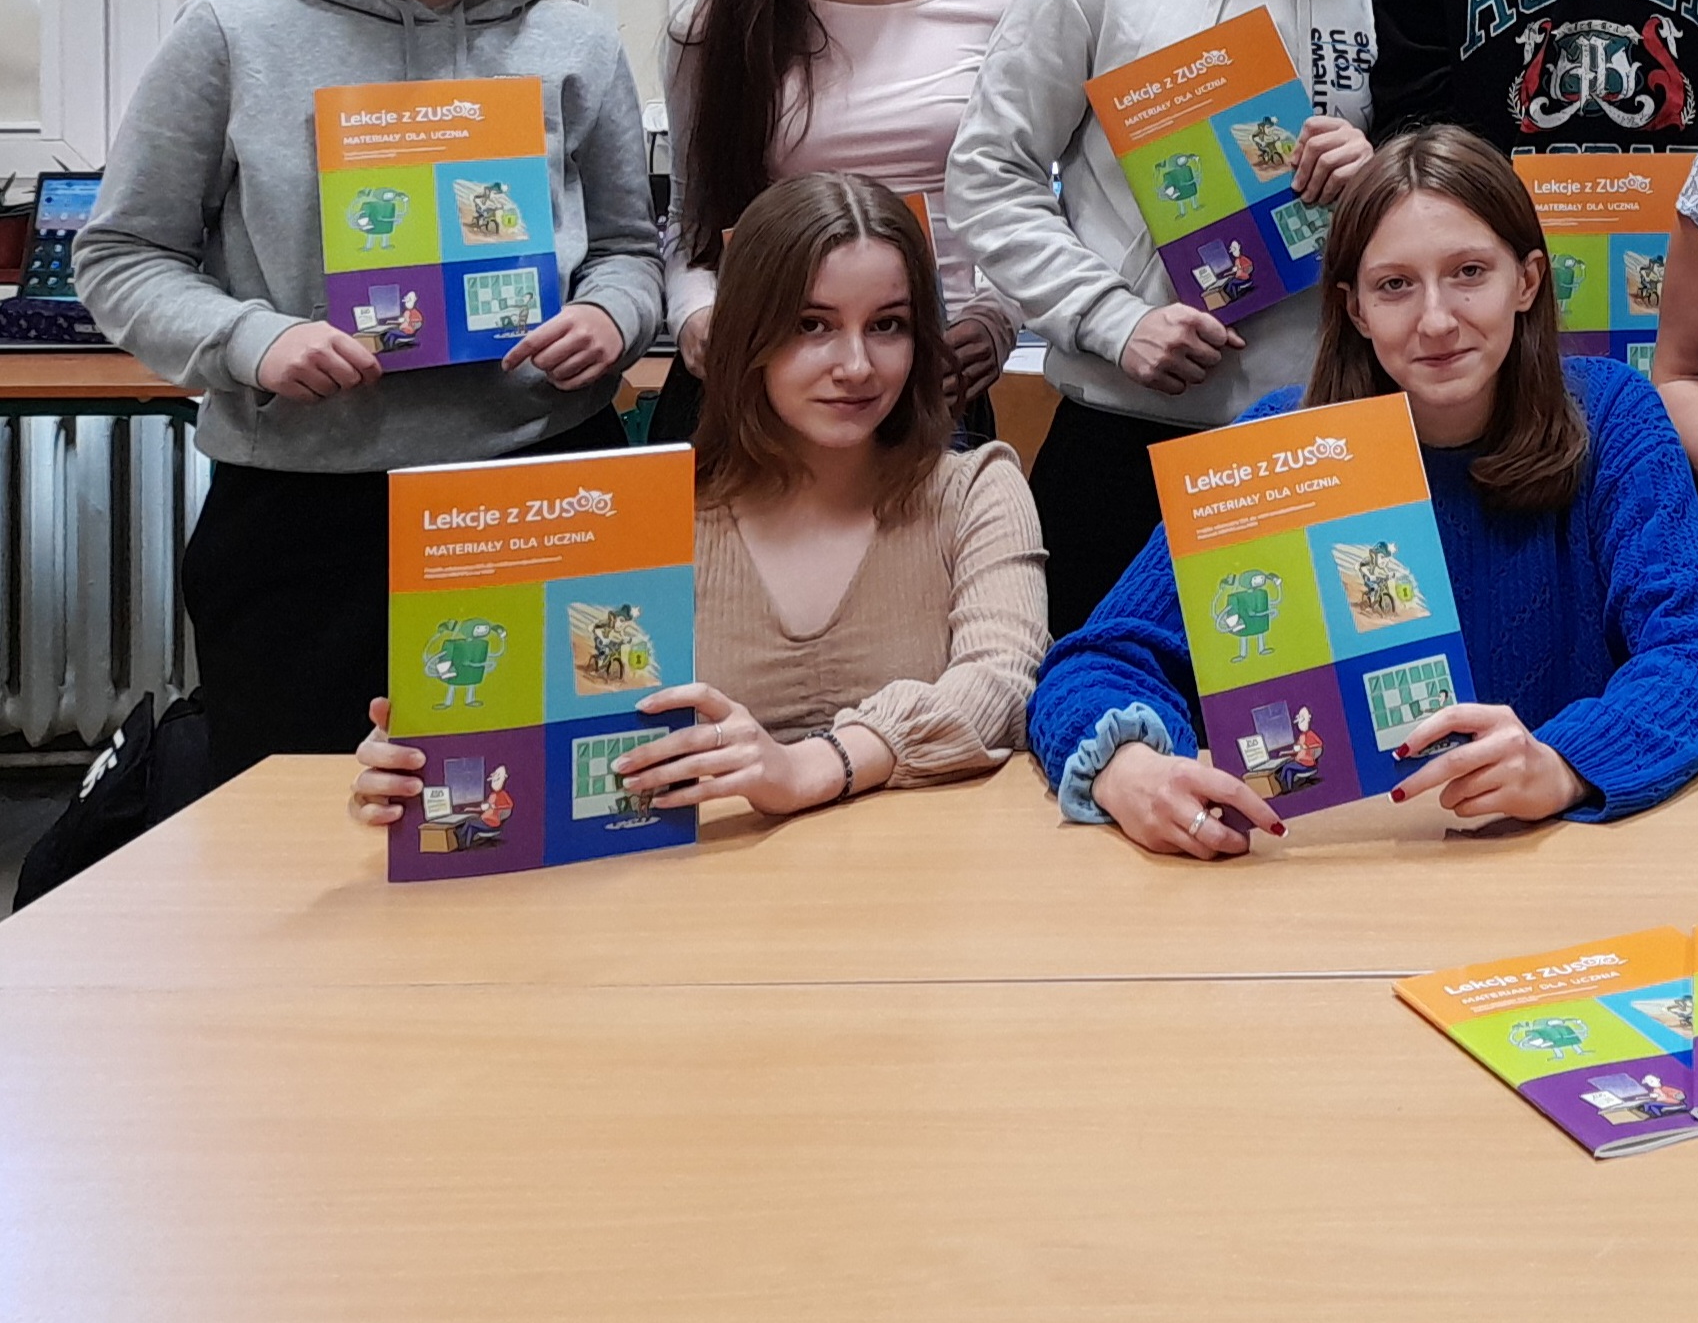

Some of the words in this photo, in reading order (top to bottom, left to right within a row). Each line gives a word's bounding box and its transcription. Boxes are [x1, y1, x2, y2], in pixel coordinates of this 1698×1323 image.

[1329, 30, 1352, 90] from
[1352, 32, 1371, 74] the
[1114, 81, 1162, 111] Lekcje
[1164, 78, 1174, 89] z
[341, 110, 397, 127] Lekcje
[402, 112, 411, 122] z
[431, 130, 469, 139] UCZNIA
[1534, 180, 1580, 196] Lekcje
[1585, 183, 1592, 192] z
[1587, 203, 1604, 211] DLA
[1607, 203, 1639, 211] UCZNIA
[1185, 463, 1252, 494] Lekcje
[1258, 461, 1269, 477] z
[1193, 493, 1260, 519] MATERIAŁY
[1266, 487, 1290, 502] DLA
[1295, 476, 1341, 494] UCZNIA
[424, 505, 500, 530] Lekcje
[507, 508, 518, 523] z
[424, 540, 503, 557] MATERIAŁY
[510, 537, 537, 550] DLA
[544, 530, 595, 547] UCZNIA
[1443, 975, 1518, 995] Lekcje
